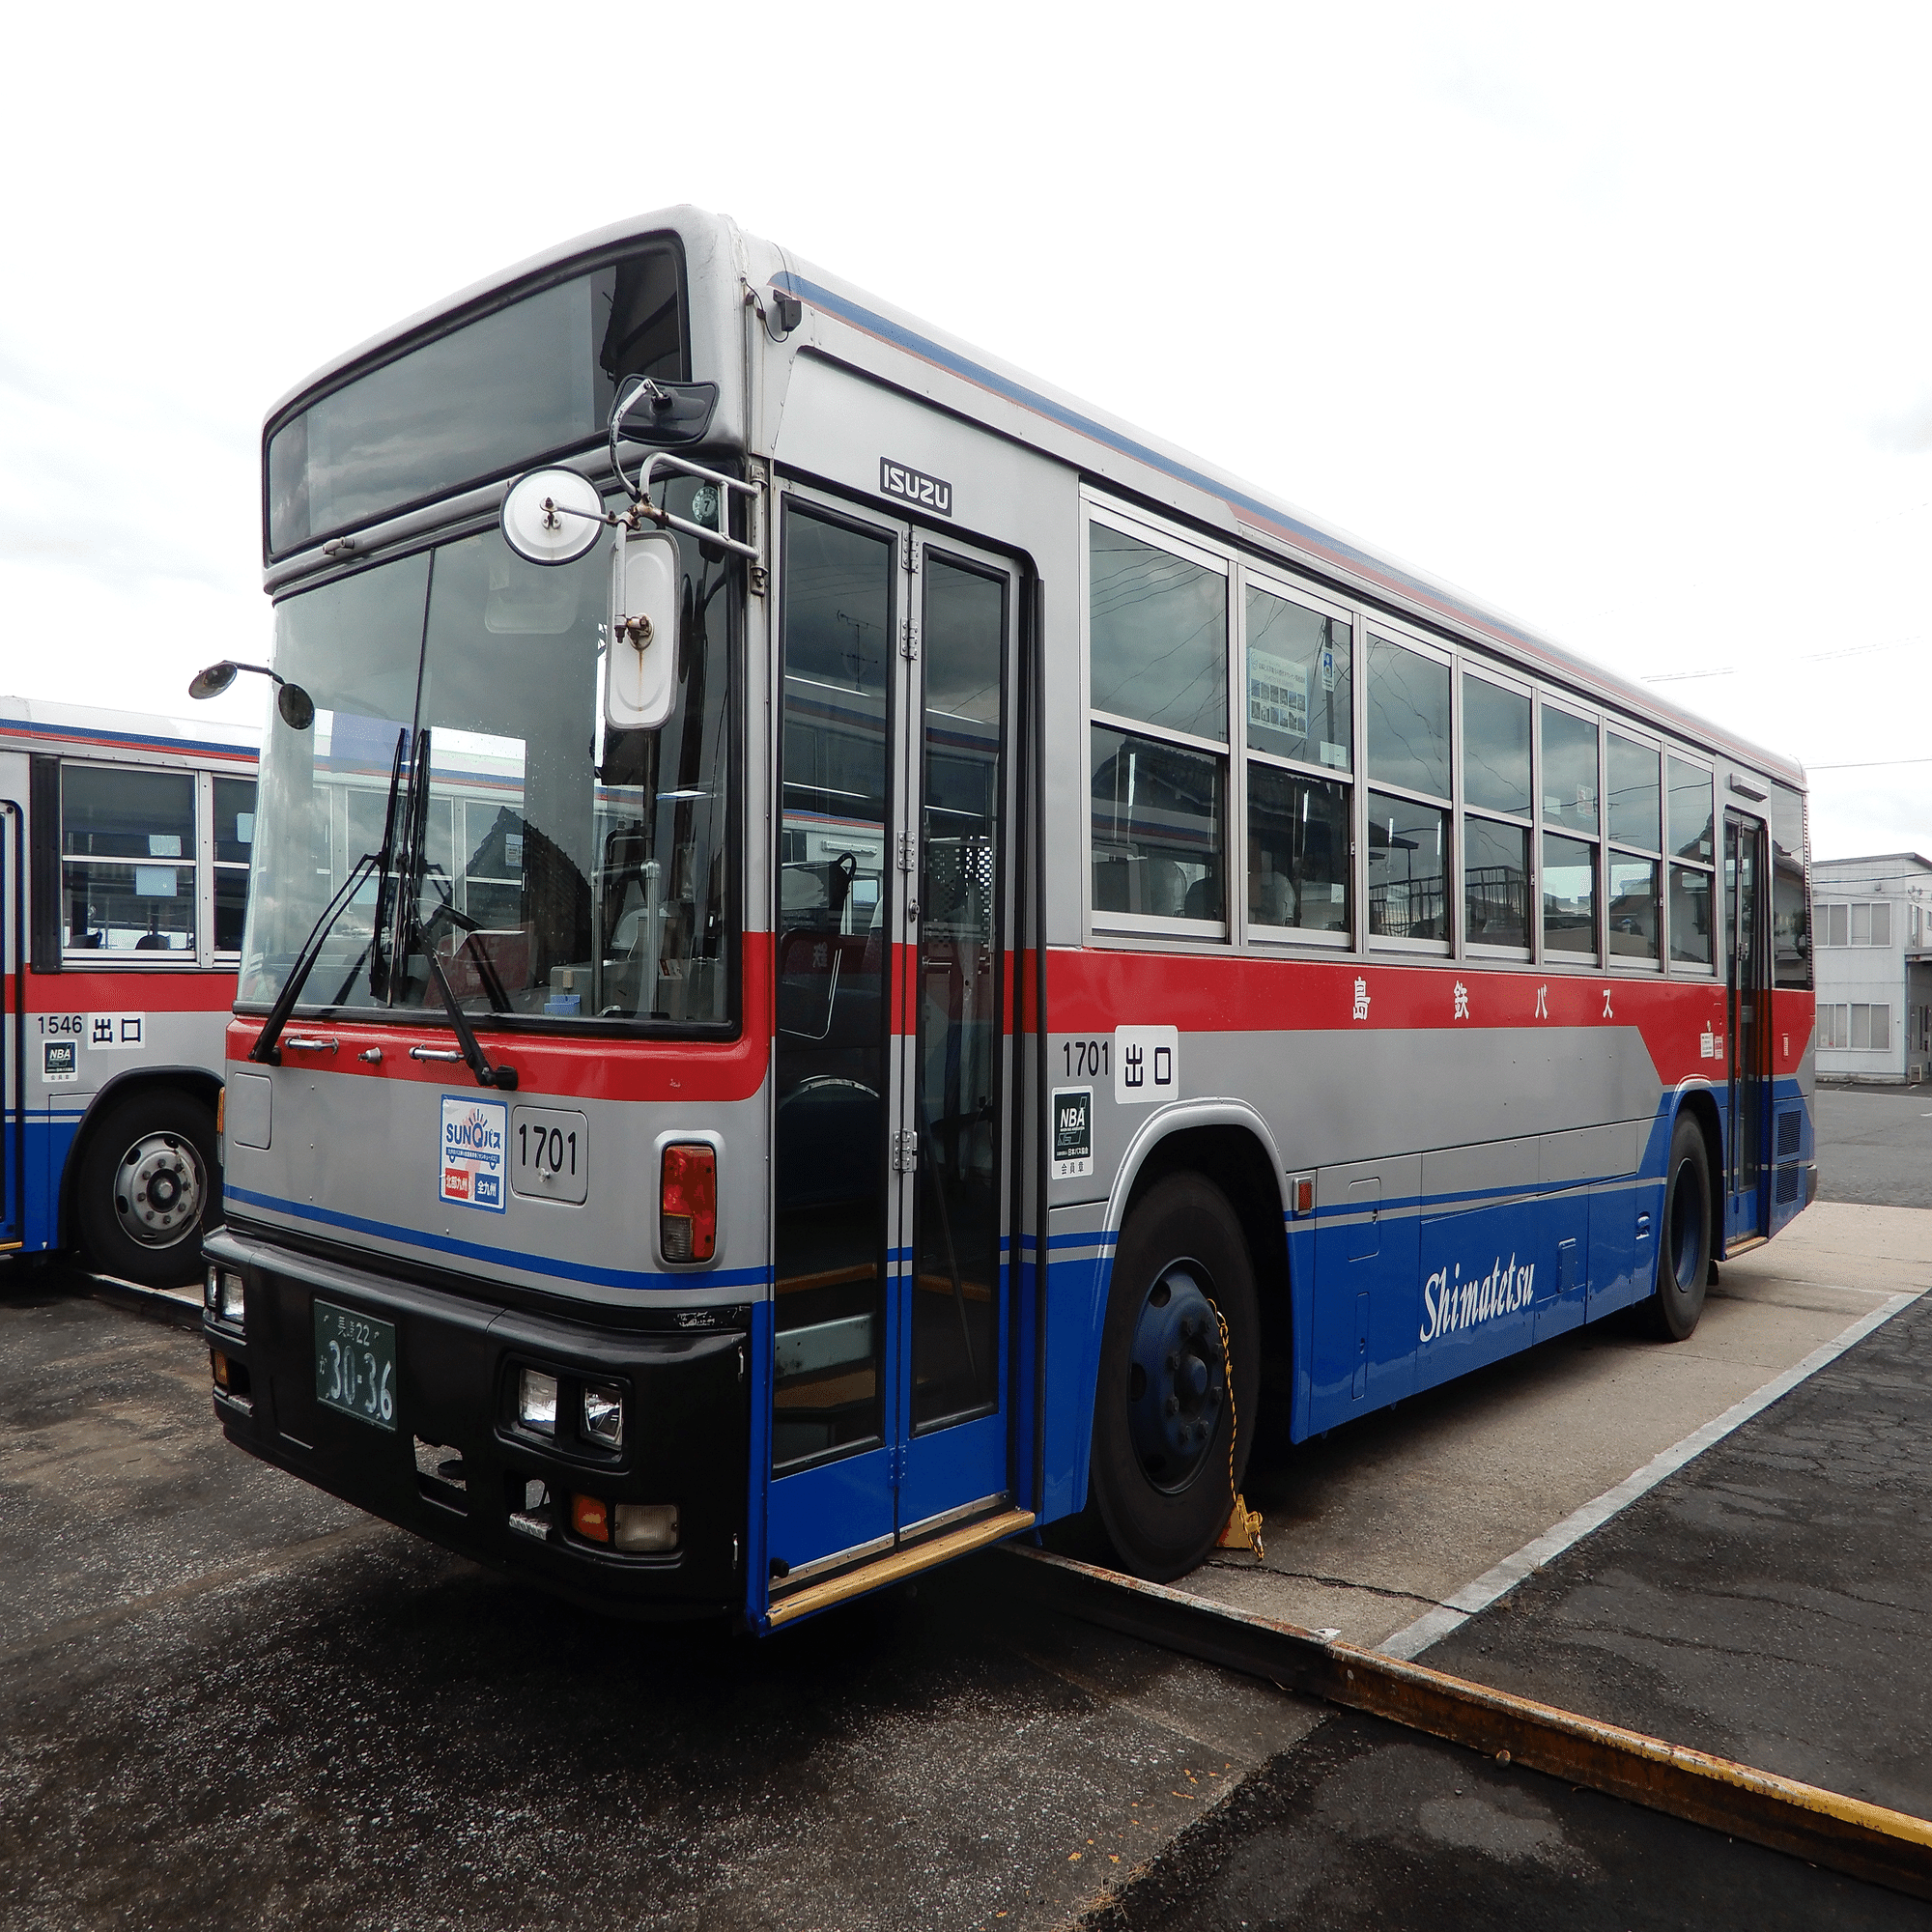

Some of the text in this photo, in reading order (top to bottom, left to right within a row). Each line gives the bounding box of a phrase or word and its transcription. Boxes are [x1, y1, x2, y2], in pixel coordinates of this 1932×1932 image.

[884, 464, 949, 510] ISUZU
[704, 500, 711, 512] 7
[37, 1015, 83, 1035] 1546
[93, 1018, 142, 1043] 出口
[49, 1048, 71, 1060] NBA
[1064, 1040, 1109, 1077] 1701
[1124, 1043, 1172, 1088] 出口
[1060, 1107, 1086, 1128] NBA
[519, 1122, 577, 1176] 1701
[477, 1179, 497, 1198] 全九州
[1419, 1251, 1535, 1343] Shimatetsu
